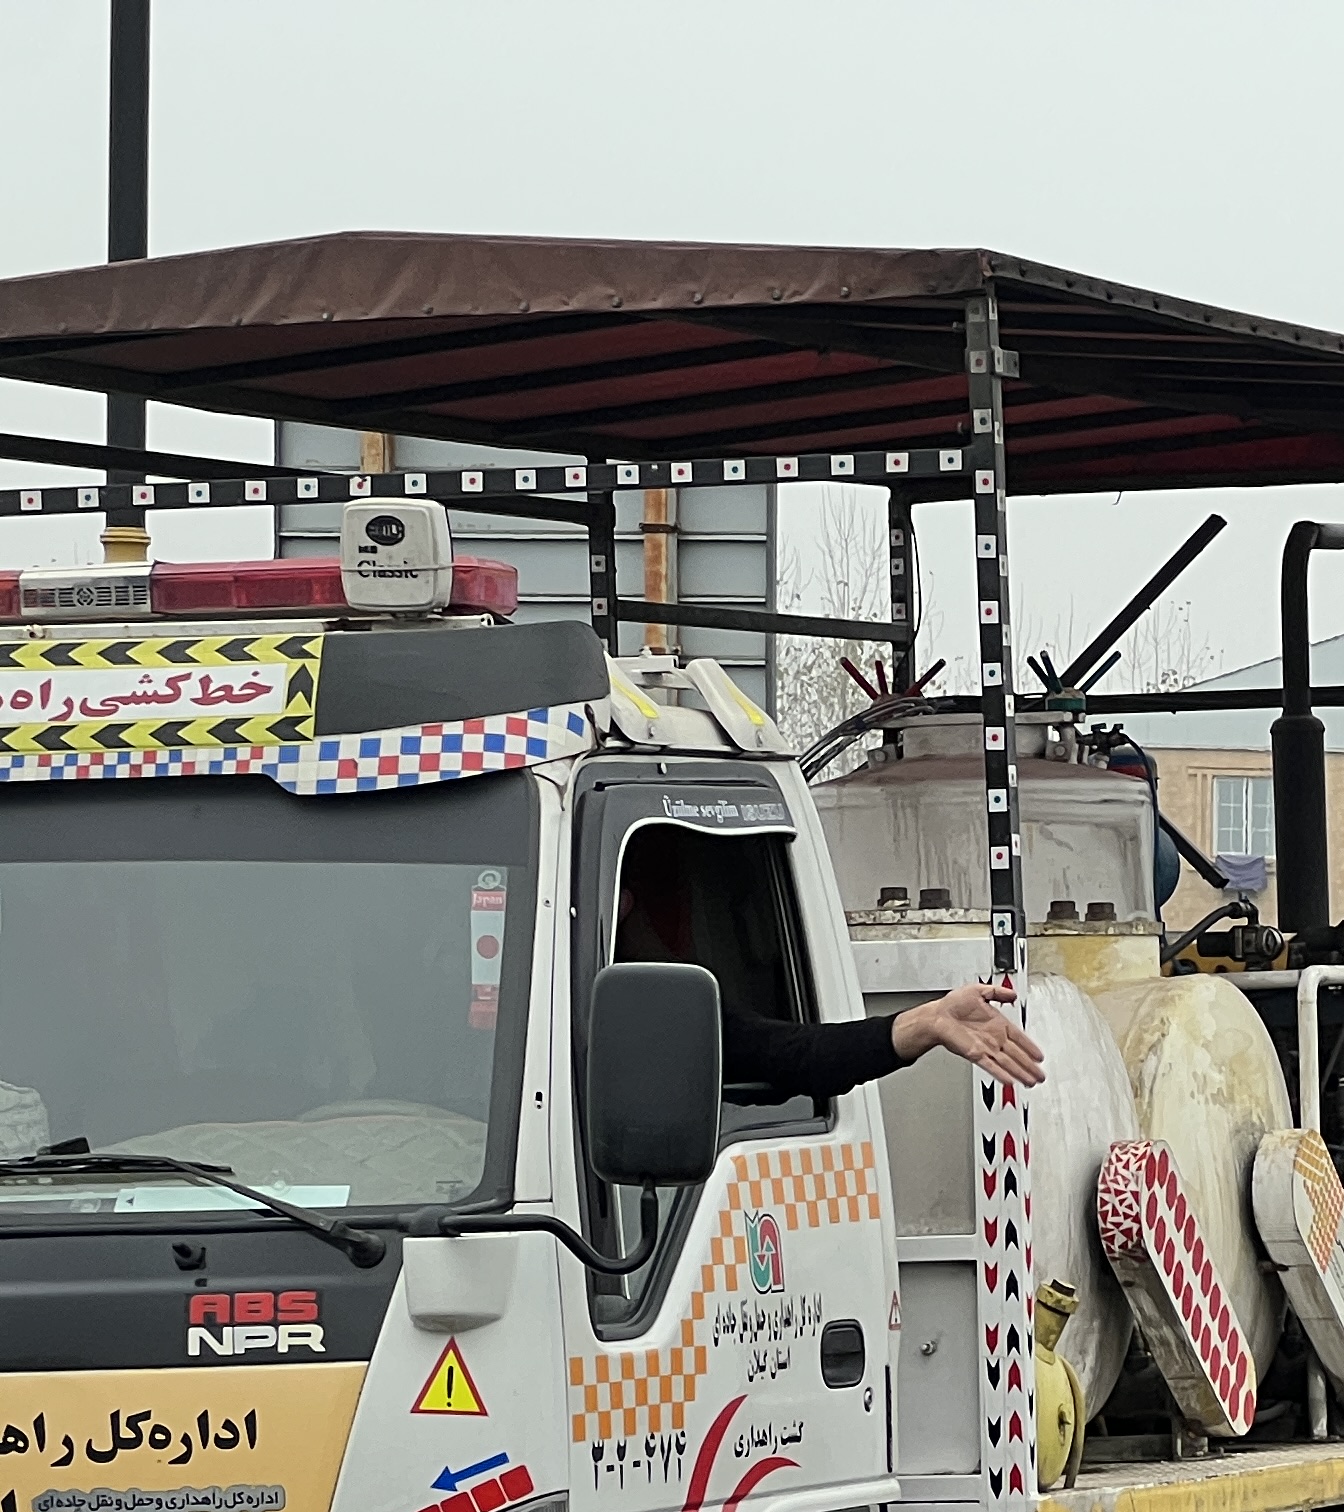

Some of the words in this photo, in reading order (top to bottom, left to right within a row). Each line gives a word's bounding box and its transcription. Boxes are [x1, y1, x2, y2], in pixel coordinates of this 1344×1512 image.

[79, 671, 193, 718] کشی
[189, 670, 274, 707] خط
[189, 1290, 319, 1326] ABS
[187, 1323, 327, 1357] NPR
[85, 1408, 152, 1464] کل
[148, 1408, 259, 1465] اداره
[734, 1421, 778, 1458] راهداری
[88, 1494, 115, 1511] نقل
[124, 1493, 154, 1510] حمل
[164, 1492, 223, 1511] راهداری
[224, 1491, 245, 1510] کل
[246, 1491, 279, 1508] اداره
